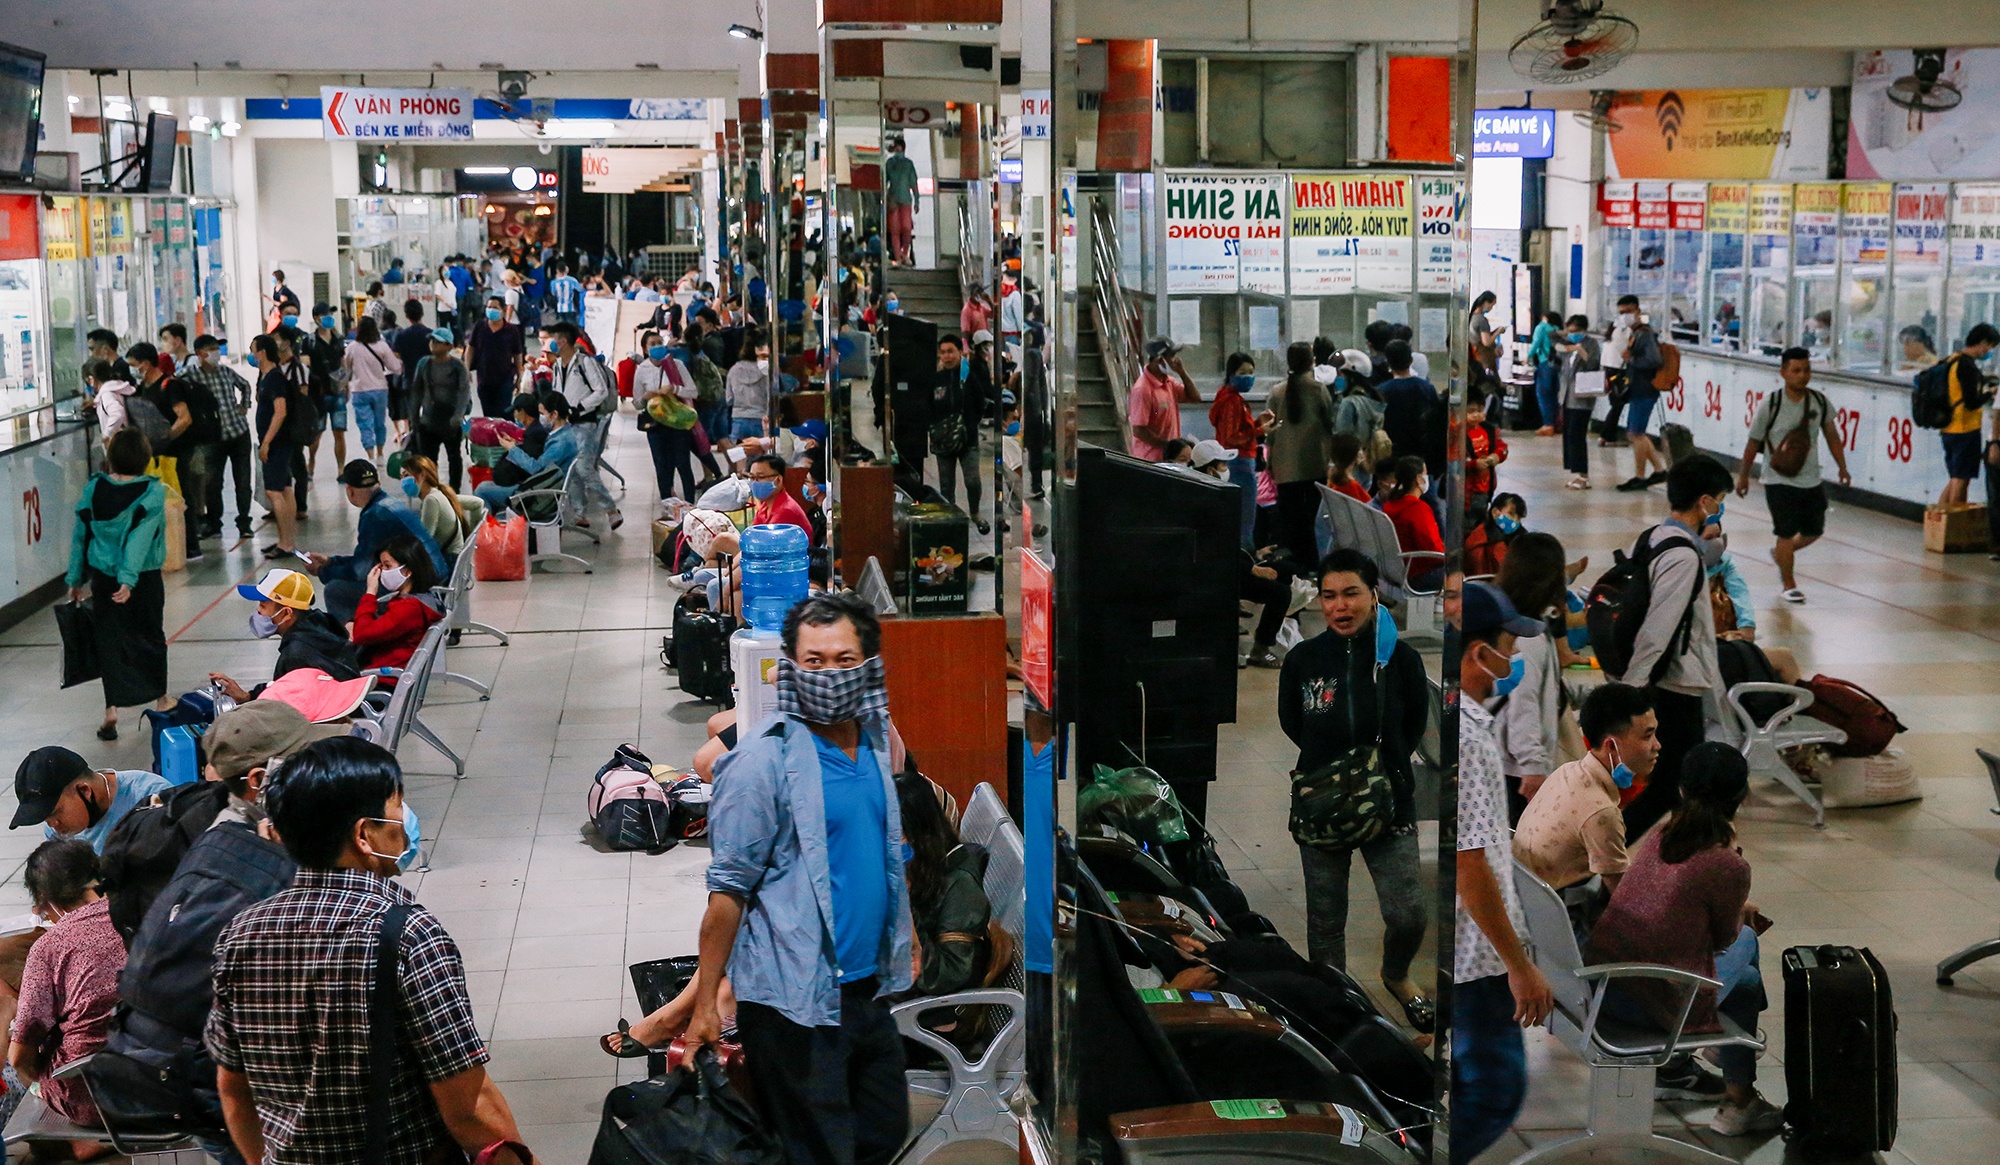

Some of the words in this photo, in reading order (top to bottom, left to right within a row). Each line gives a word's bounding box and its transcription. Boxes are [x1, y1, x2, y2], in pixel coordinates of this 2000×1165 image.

[355, 93, 390, 115] VĂN
[400, 92, 461, 115] PHÒNG
[356, 123, 379, 136] BẾN
[384, 125, 399, 136] XE
[404, 120, 433, 136] MIỀN
[438, 122, 470, 136] ĐÔNG
[1492, 115, 1520, 134] BÁN
[1520, 115, 1538, 134] VÉ
[1492, 140, 1519, 153] Area
[1704, 381, 1722, 421] 34
[1838, 407, 1860, 451] 37
[1888, 416, 1912, 463] 38
[23, 486, 42, 546] 73
